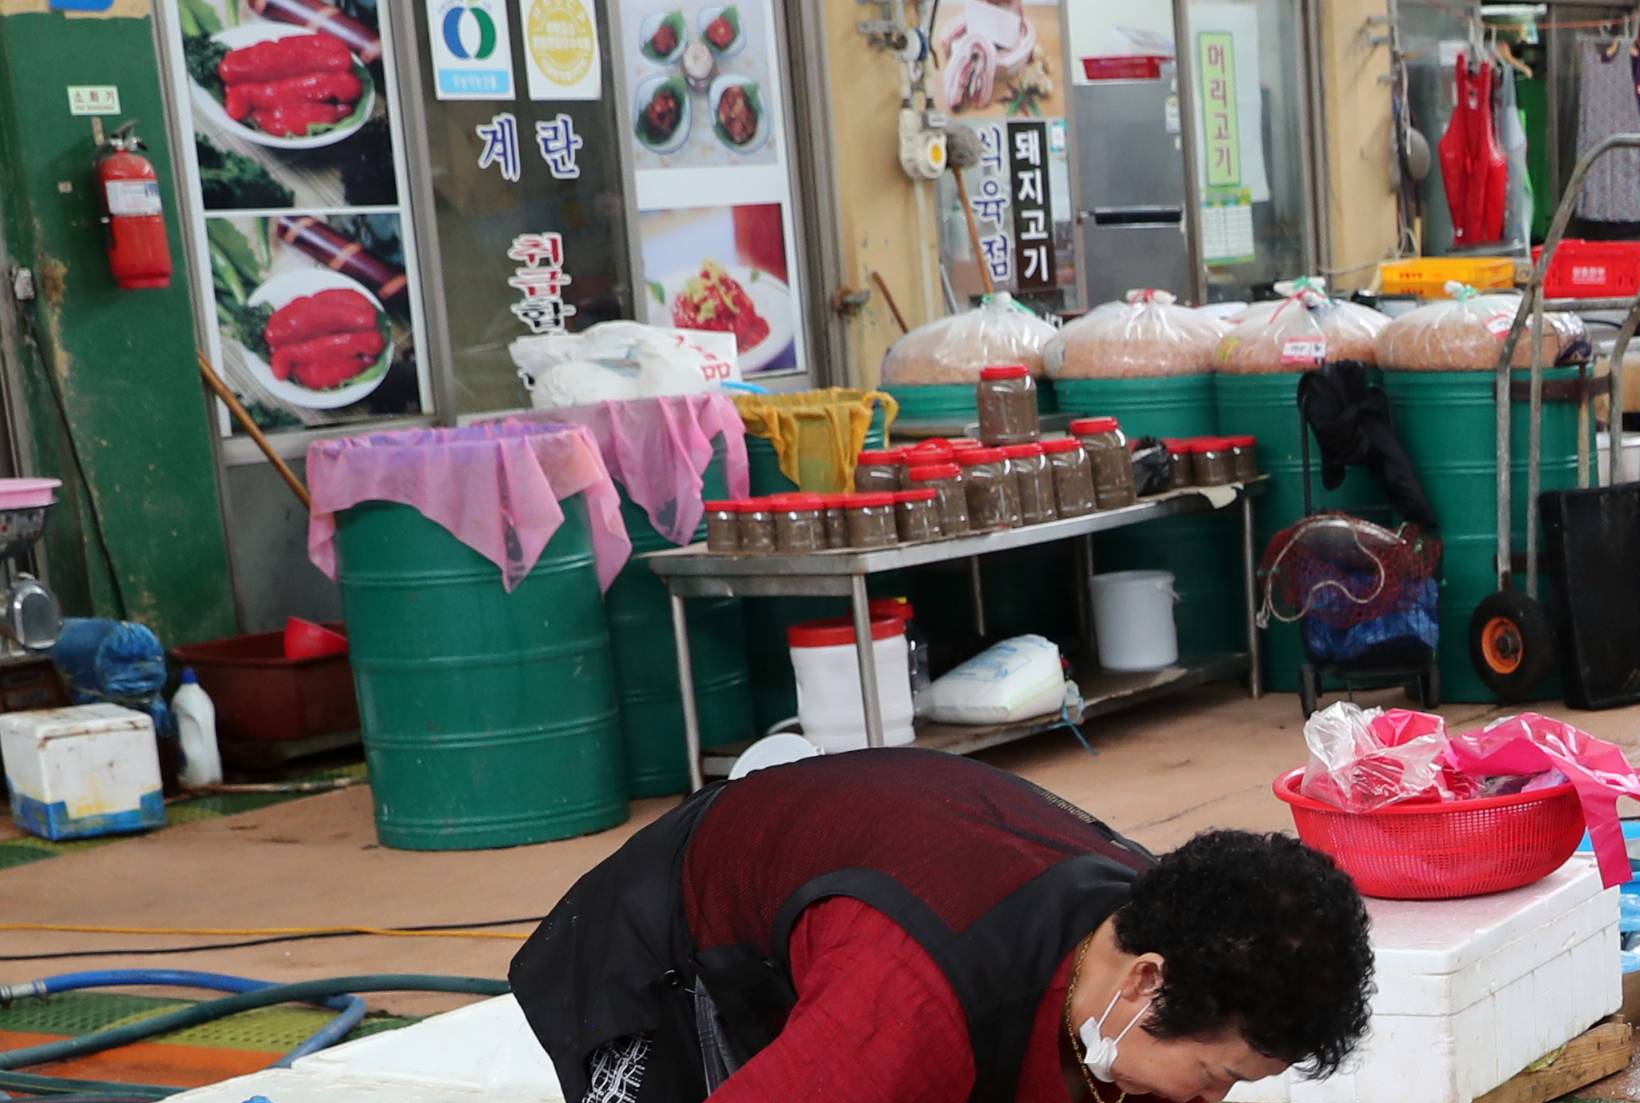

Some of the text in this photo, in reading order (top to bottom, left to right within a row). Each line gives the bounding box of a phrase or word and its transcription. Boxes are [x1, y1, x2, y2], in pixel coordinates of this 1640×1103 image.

[478, 114, 582, 180] 계란
[1207, 45, 1231, 175] 머리고기
[974, 126, 1010, 279] 식육점
[1015, 129, 1049, 282] 돼지고기
